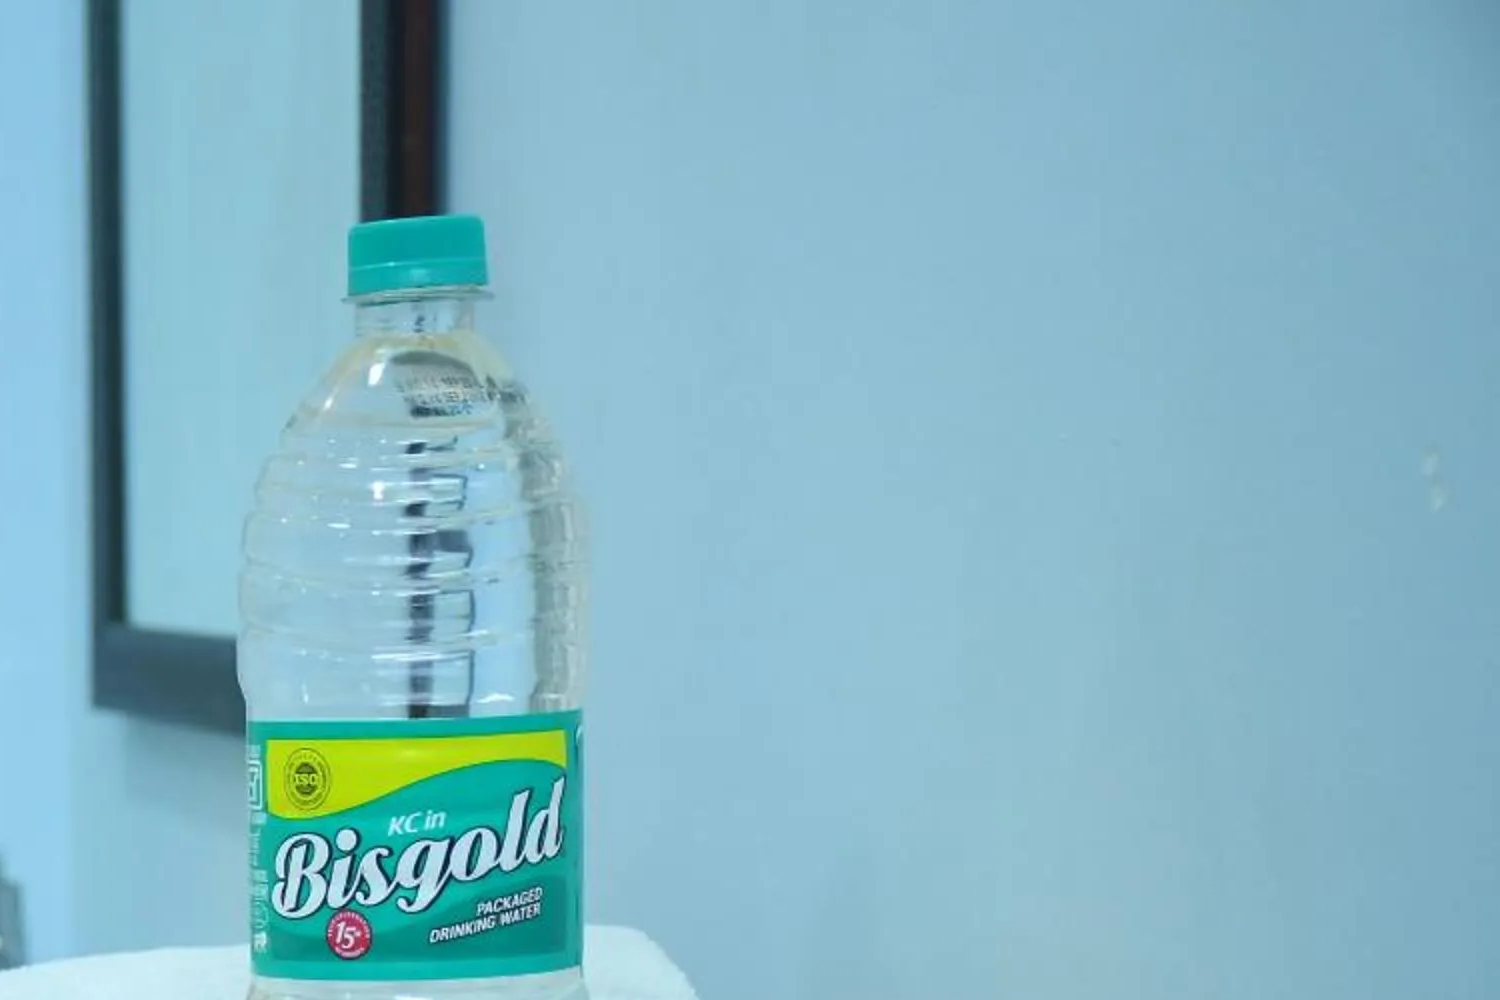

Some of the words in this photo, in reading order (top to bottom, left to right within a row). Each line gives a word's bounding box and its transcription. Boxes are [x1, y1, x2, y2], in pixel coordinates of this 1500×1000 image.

[294, 773, 319, 786] ISO
[388, 811, 423, 836] KC
[425, 810, 447, 830] in
[271, 775, 566, 920] Bisgold
[476, 887, 543, 916] PACKAGED
[429, 915, 496, 943] DRINKING
[499, 903, 541, 926] WATER
